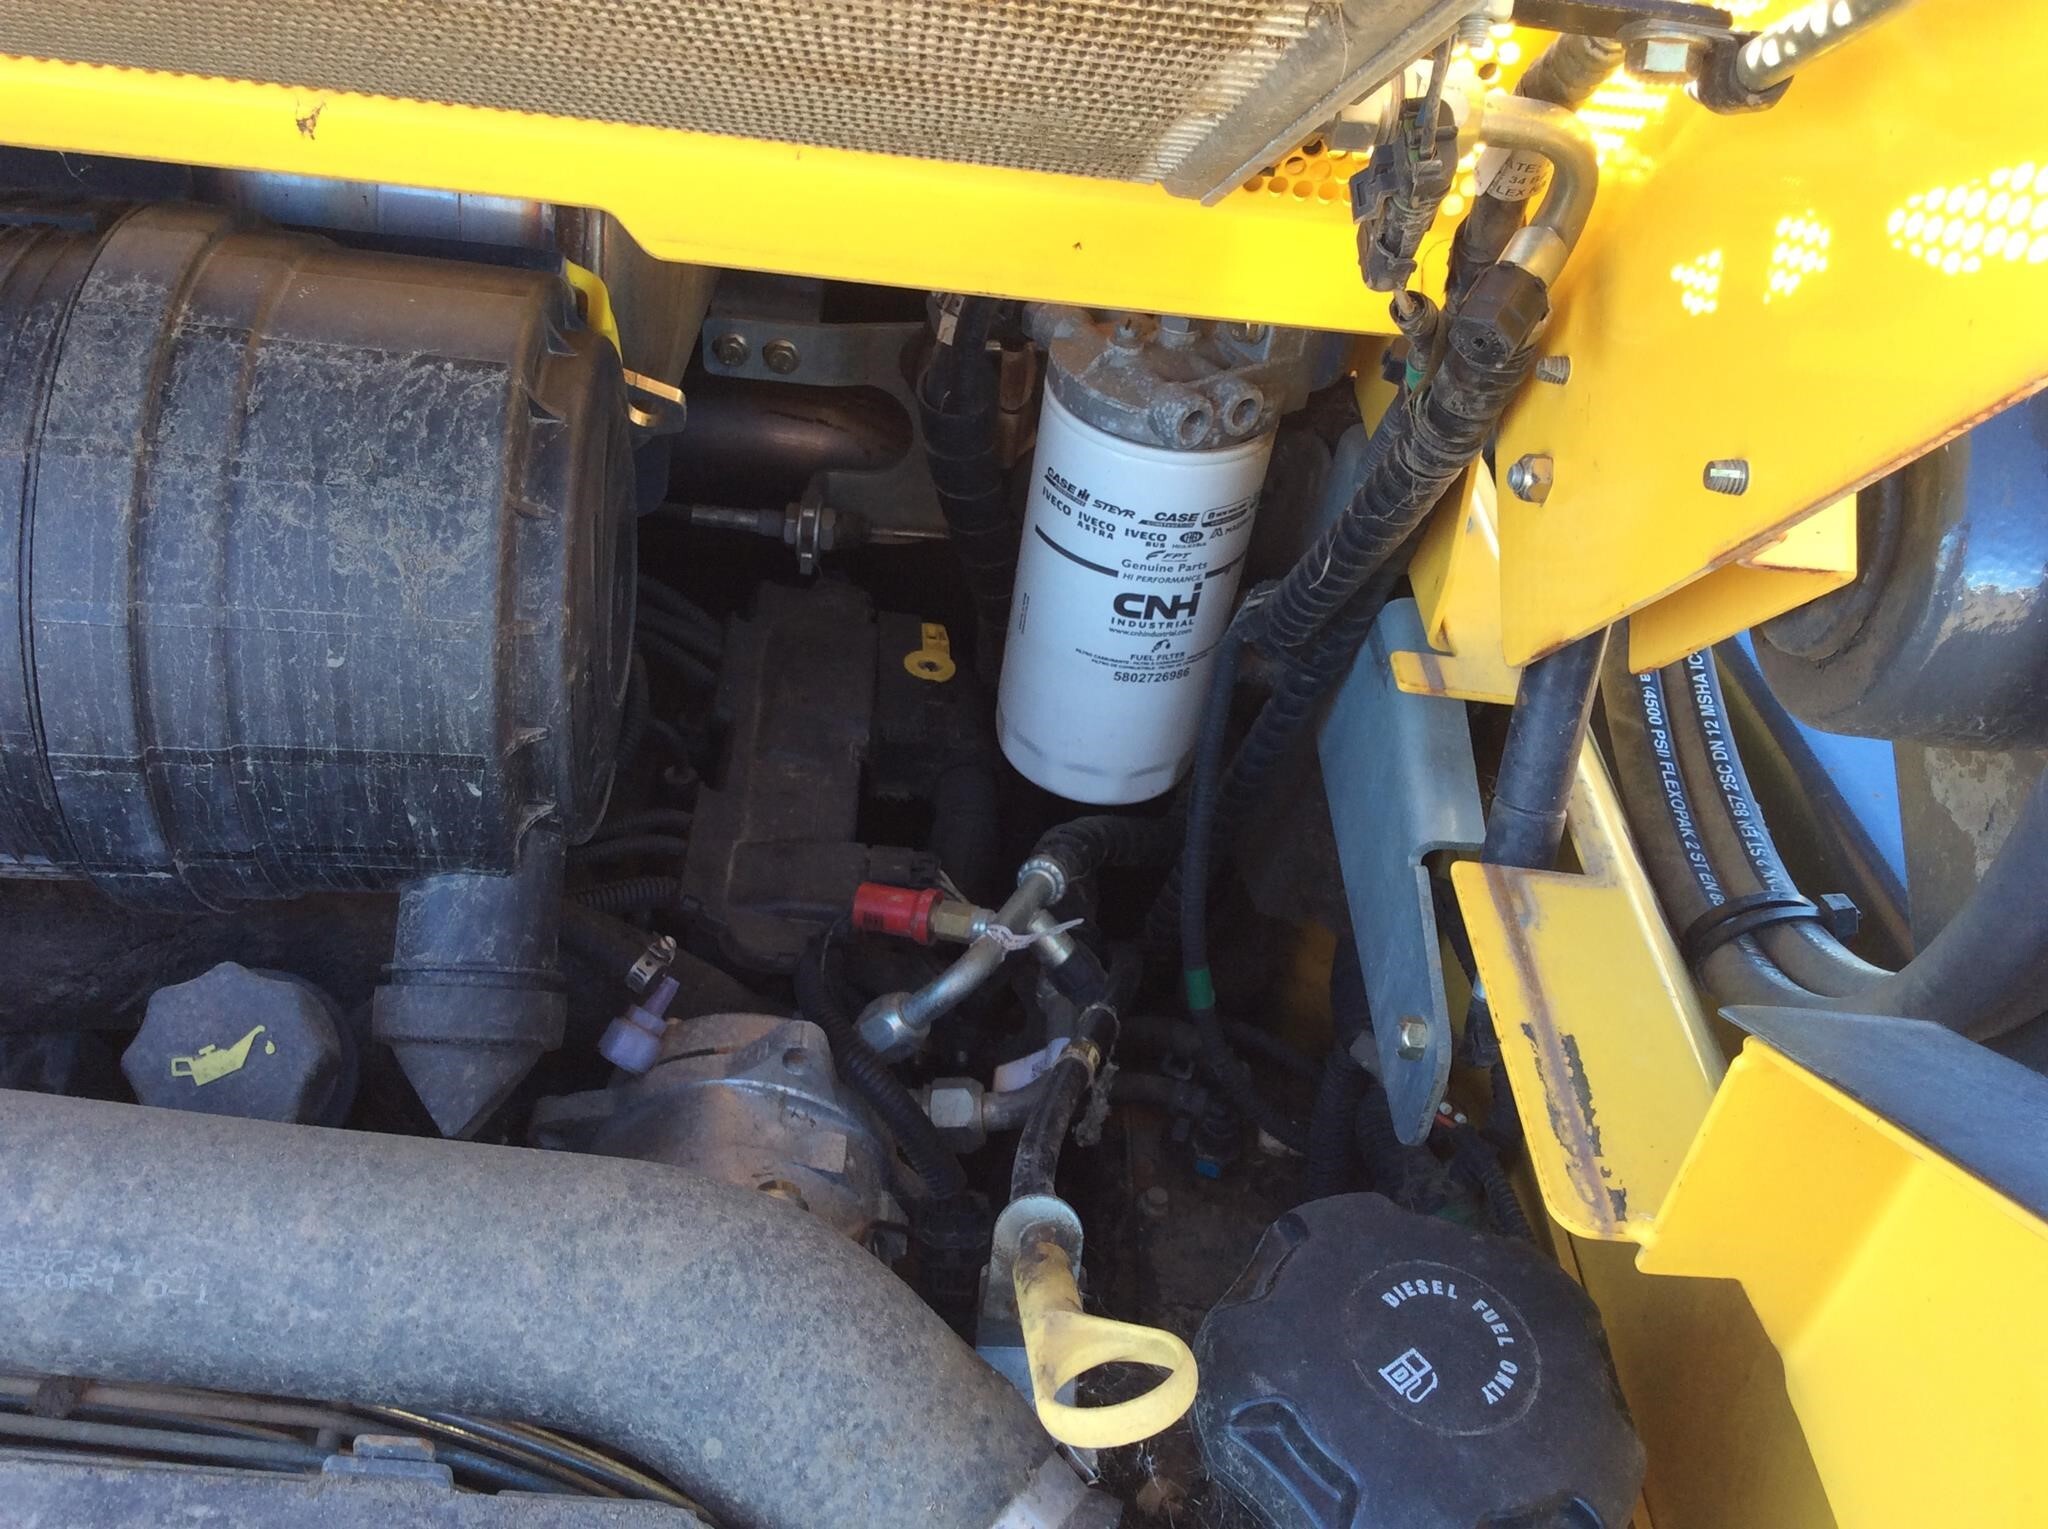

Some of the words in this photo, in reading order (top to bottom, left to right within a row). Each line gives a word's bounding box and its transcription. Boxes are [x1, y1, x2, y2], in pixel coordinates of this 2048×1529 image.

[1047, 466, 1077, 495] CASE
[1042, 486, 1072, 516] IVECO
[1092, 499, 1136, 519] STEYR
[1078, 511, 1116, 532] IVECO
[1154, 511, 1200, 522] CASE
[1077, 520, 1114, 540] ASTRA
[1124, 528, 1167, 542] IVECO
[1145, 541, 1166, 549] BUS
[1121, 559, 1174, 573] Genuine
[1178, 562, 1208, 572] Parts
[1136, 574, 1202, 584] PERFORMANCE
[1111, 616, 1194, 630] INDUSTRIAL
[1130, 653, 1153, 661] FUEL
[1157, 651, 1186, 661] FILTER
[1692, 673, 1716, 717] MSHA
[1642, 686, 1663, 726] (4500
[1704, 720, 1721, 736] 12
[1651, 729, 1671, 758] PSI)
[1708, 740, 1729, 761] DN
[1716, 764, 1740, 791] 2SC
[1659, 761, 1697, 839] FLEXOPAK
[1727, 794, 1750, 817] 857
[1684, 841, 1701, 850] 2
[1690, 853, 1710, 870] ST
[1700, 873, 1721, 892] EN
[1381, 1279, 1458, 1308] DIESEL
[1471, 1299, 1515, 1346] FUEL
[1481, 1359, 1518, 1405] ONLY
